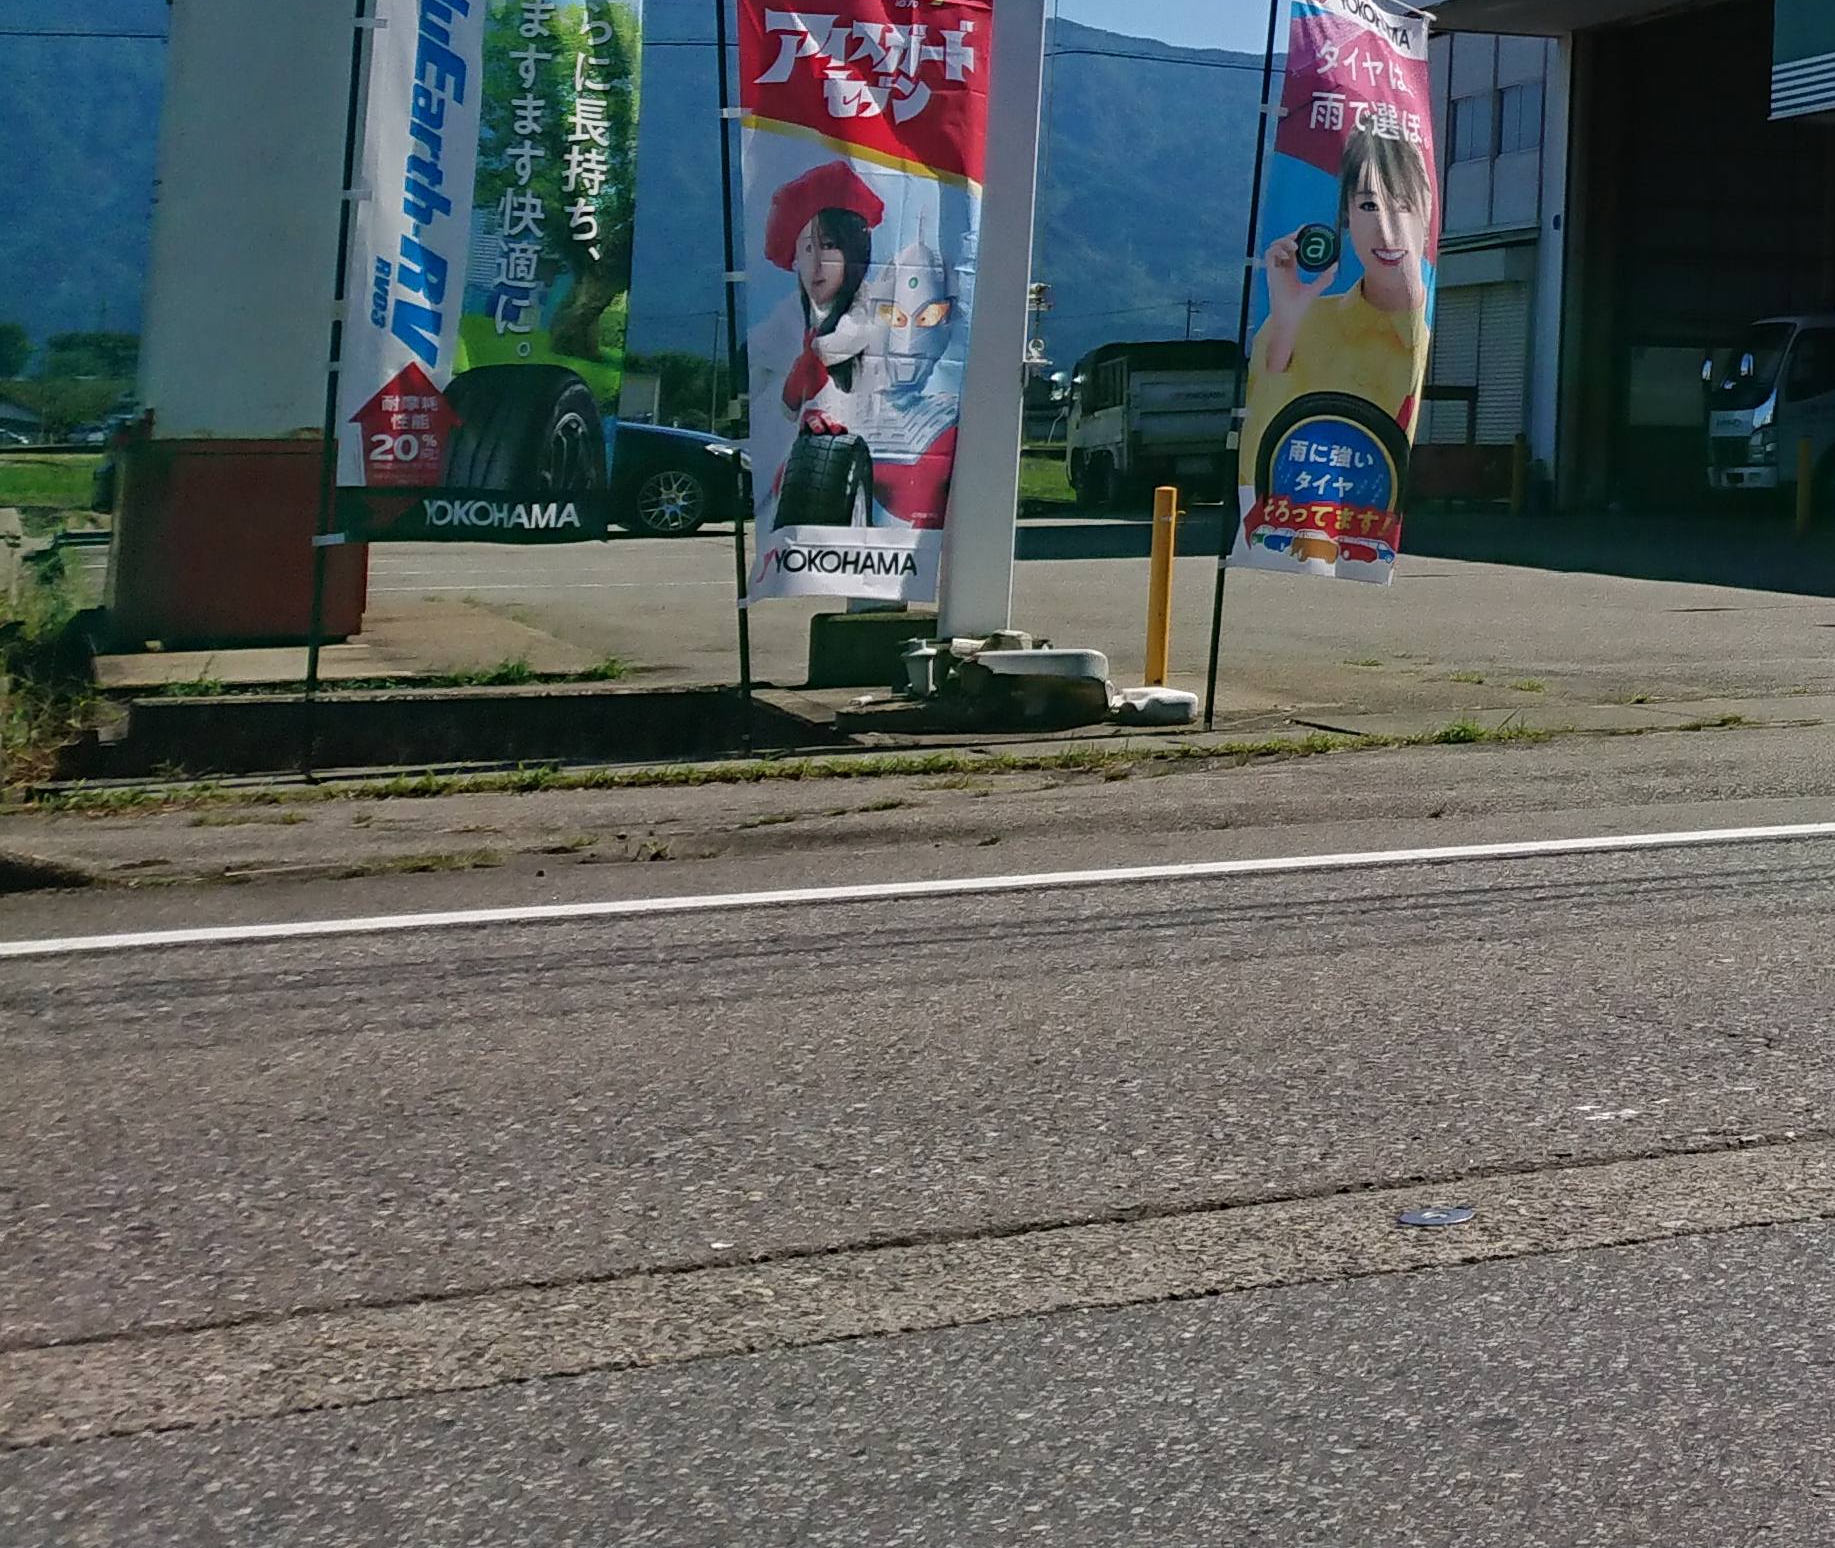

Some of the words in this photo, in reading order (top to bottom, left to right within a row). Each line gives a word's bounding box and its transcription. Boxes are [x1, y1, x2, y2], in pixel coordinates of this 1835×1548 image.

[753, 7, 976, 84] アイスガード
[1315, 40, 1415, 99] タイヤは、
[822, 69, 933, 126] セブン
[1306, 236, 1326, 260] a
[370, 255, 392, 329] RV03
[390, 413, 430, 430] 性能
[1288, 438, 1374, 469] 雨に強い
[1293, 470, 1355, 498] タイヤ
[423, 499, 582, 530] YOKOHAMA
[774, 548, 918, 577] YOKOHAMA
